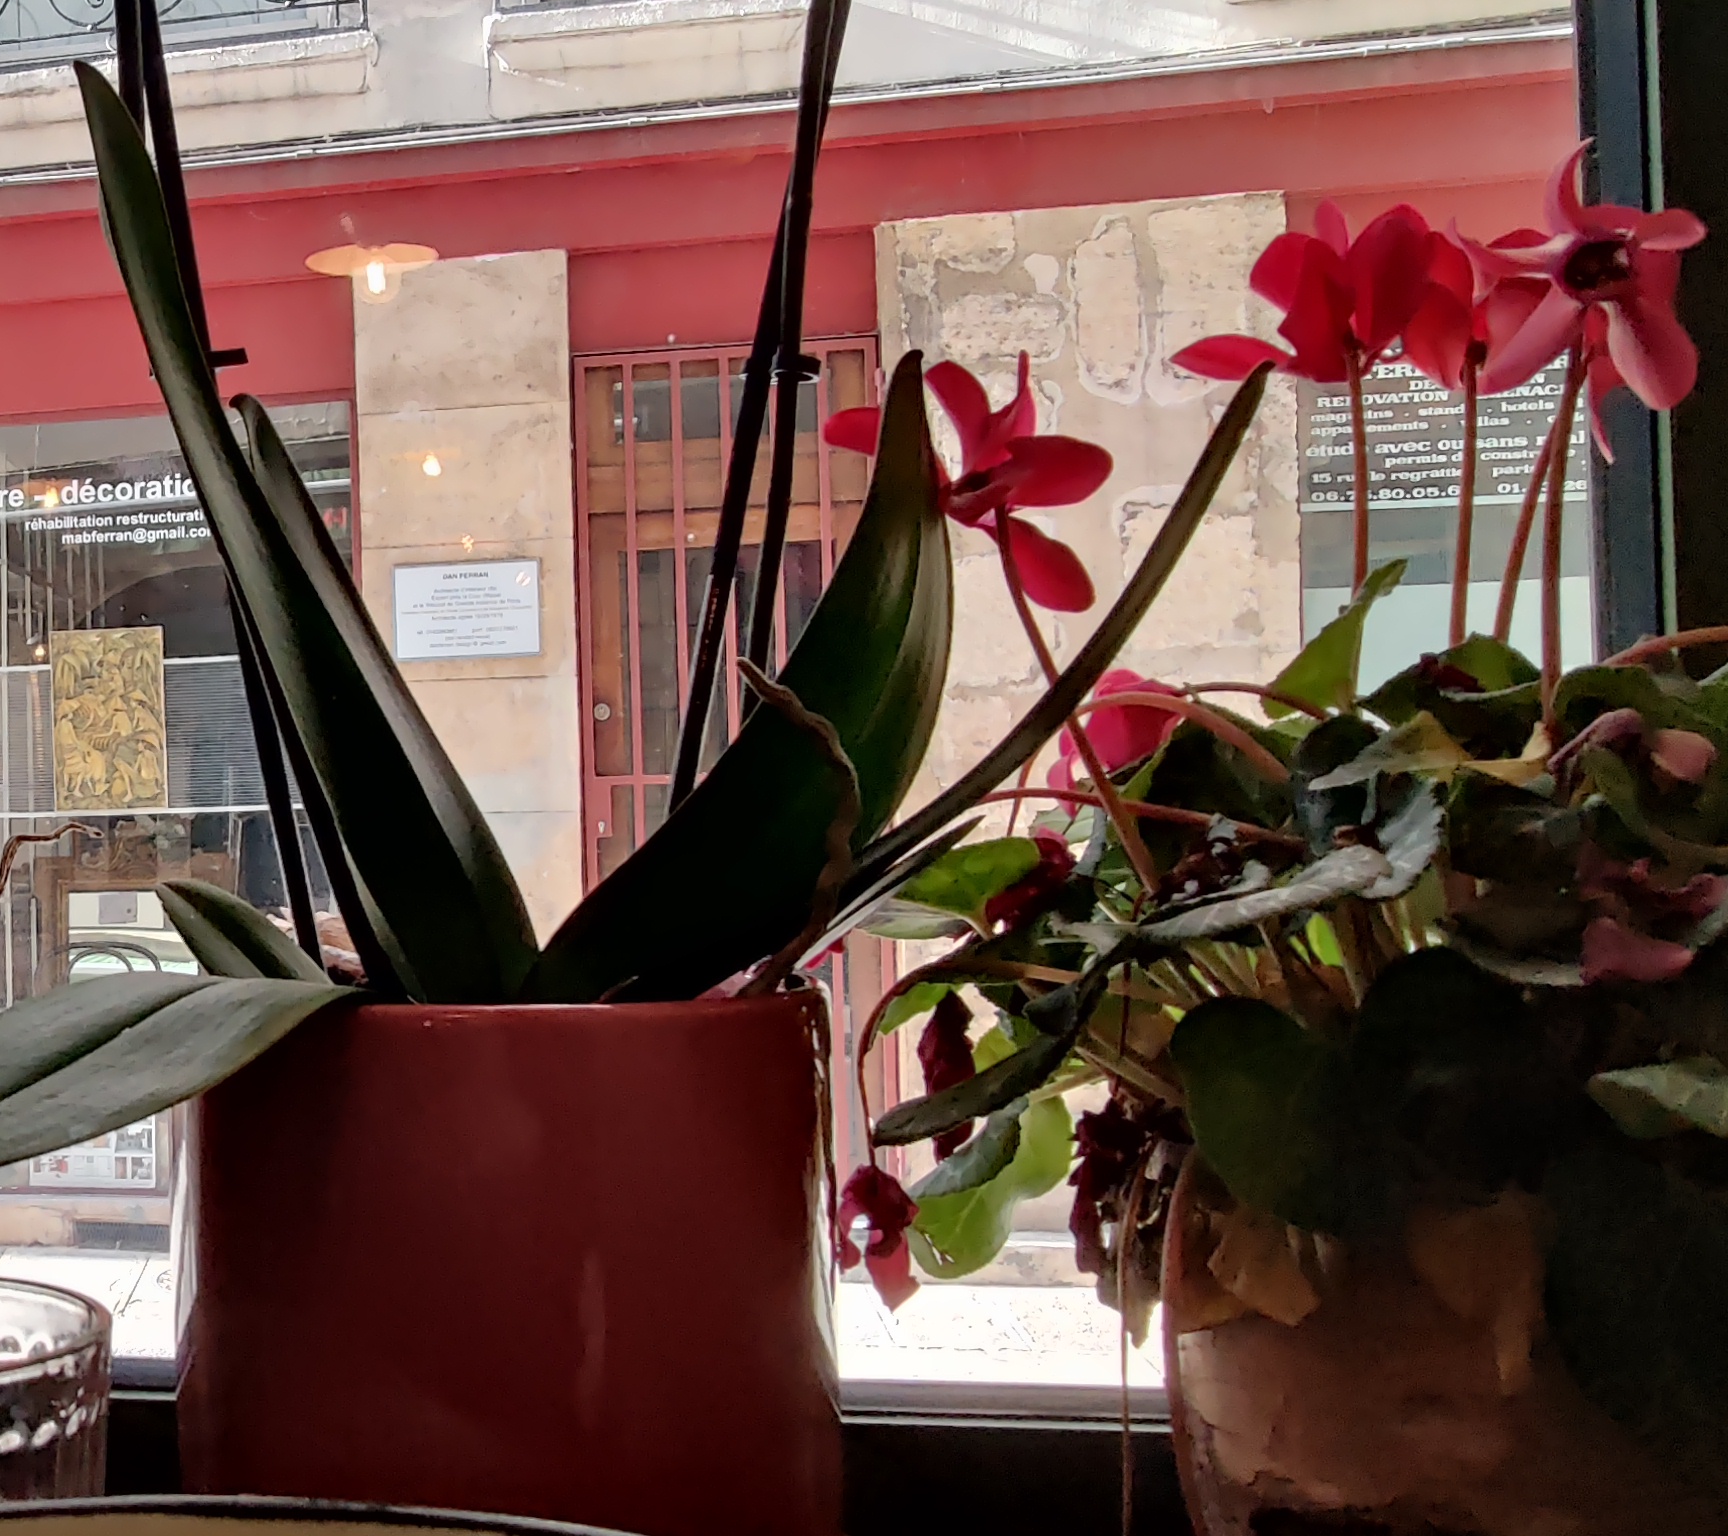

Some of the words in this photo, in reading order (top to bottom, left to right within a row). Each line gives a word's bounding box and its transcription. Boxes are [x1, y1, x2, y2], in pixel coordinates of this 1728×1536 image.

[1310, 420, 1429, 437] appaements
[1374, 440, 1431, 454] avec
[1384, 452, 1448, 468] permis
[60, 472, 196, 504] décoratio
[24, 514, 113, 531] réhabilitation
[116, 509, 204, 526] restructurati
